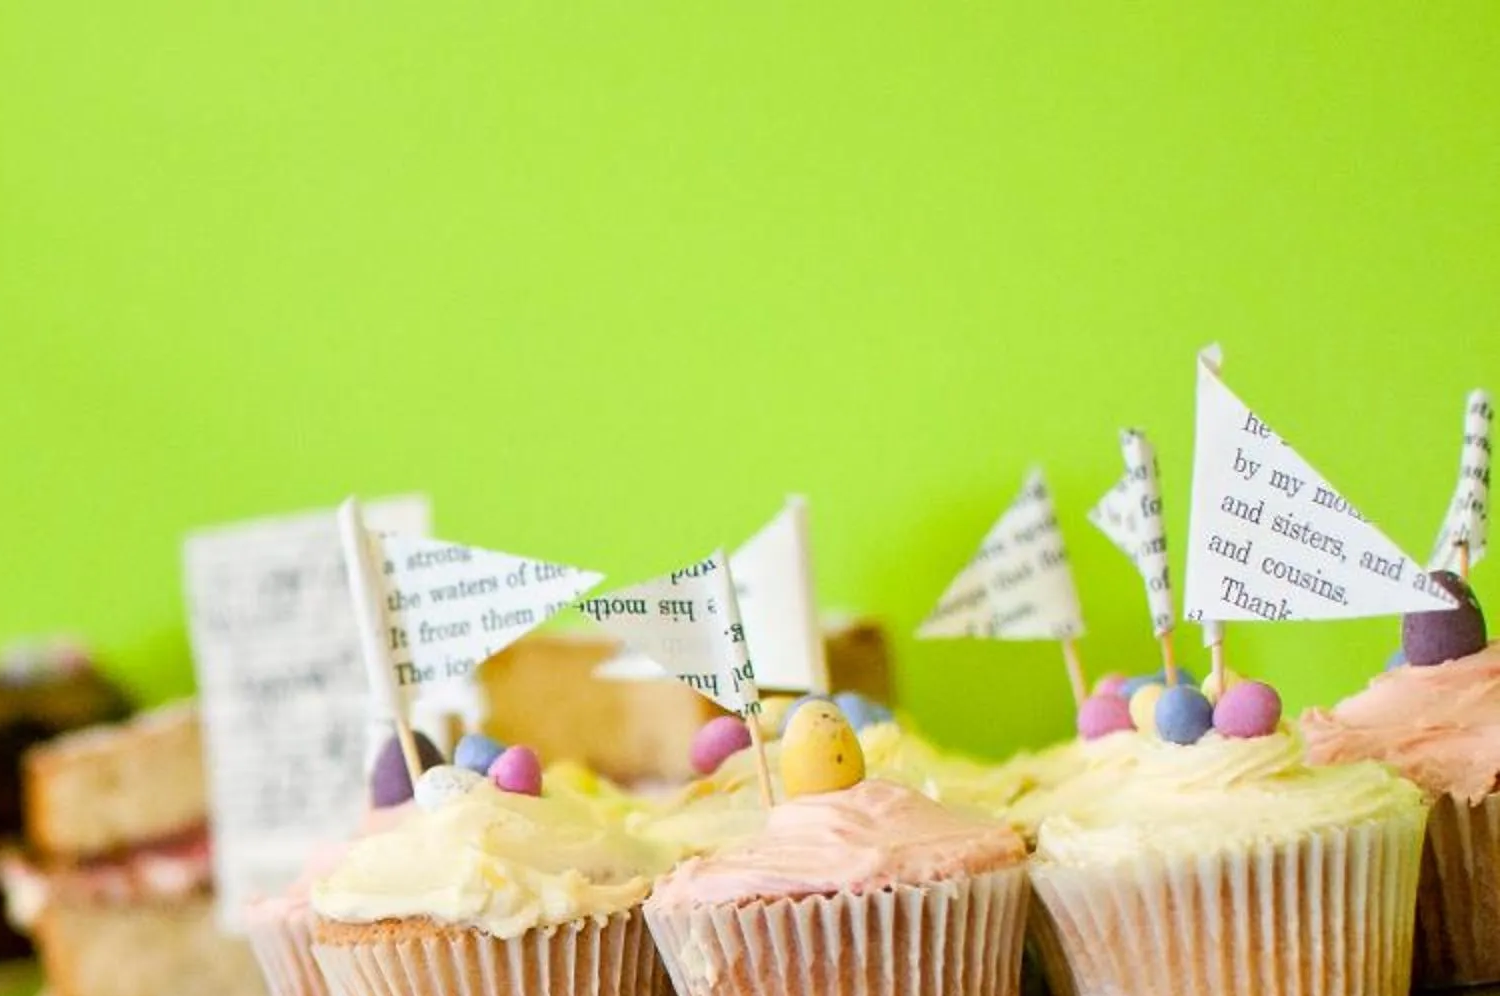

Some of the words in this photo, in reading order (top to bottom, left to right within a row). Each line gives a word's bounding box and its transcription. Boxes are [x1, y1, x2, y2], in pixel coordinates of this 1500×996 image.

[1233, 448, 1261, 480] by
[1269, 468, 1305, 499] my
[1208, 534, 1252, 565] and
[1221, 494, 1264, 524] and
[1272, 512, 1347, 562] sisters,
[1360, 551, 1404, 581] and
[383, 560, 395, 574] a
[387, 590, 420, 611] the
[429, 576, 499, 603] waters
[506, 561, 526, 588] of
[659, 599, 695, 622] his
[1221, 576, 1292, 620] Thank
[390, 627, 408, 649] It
[419, 620, 471, 645] froze
[481, 608, 534, 632] them
[395, 662, 435, 686] The
